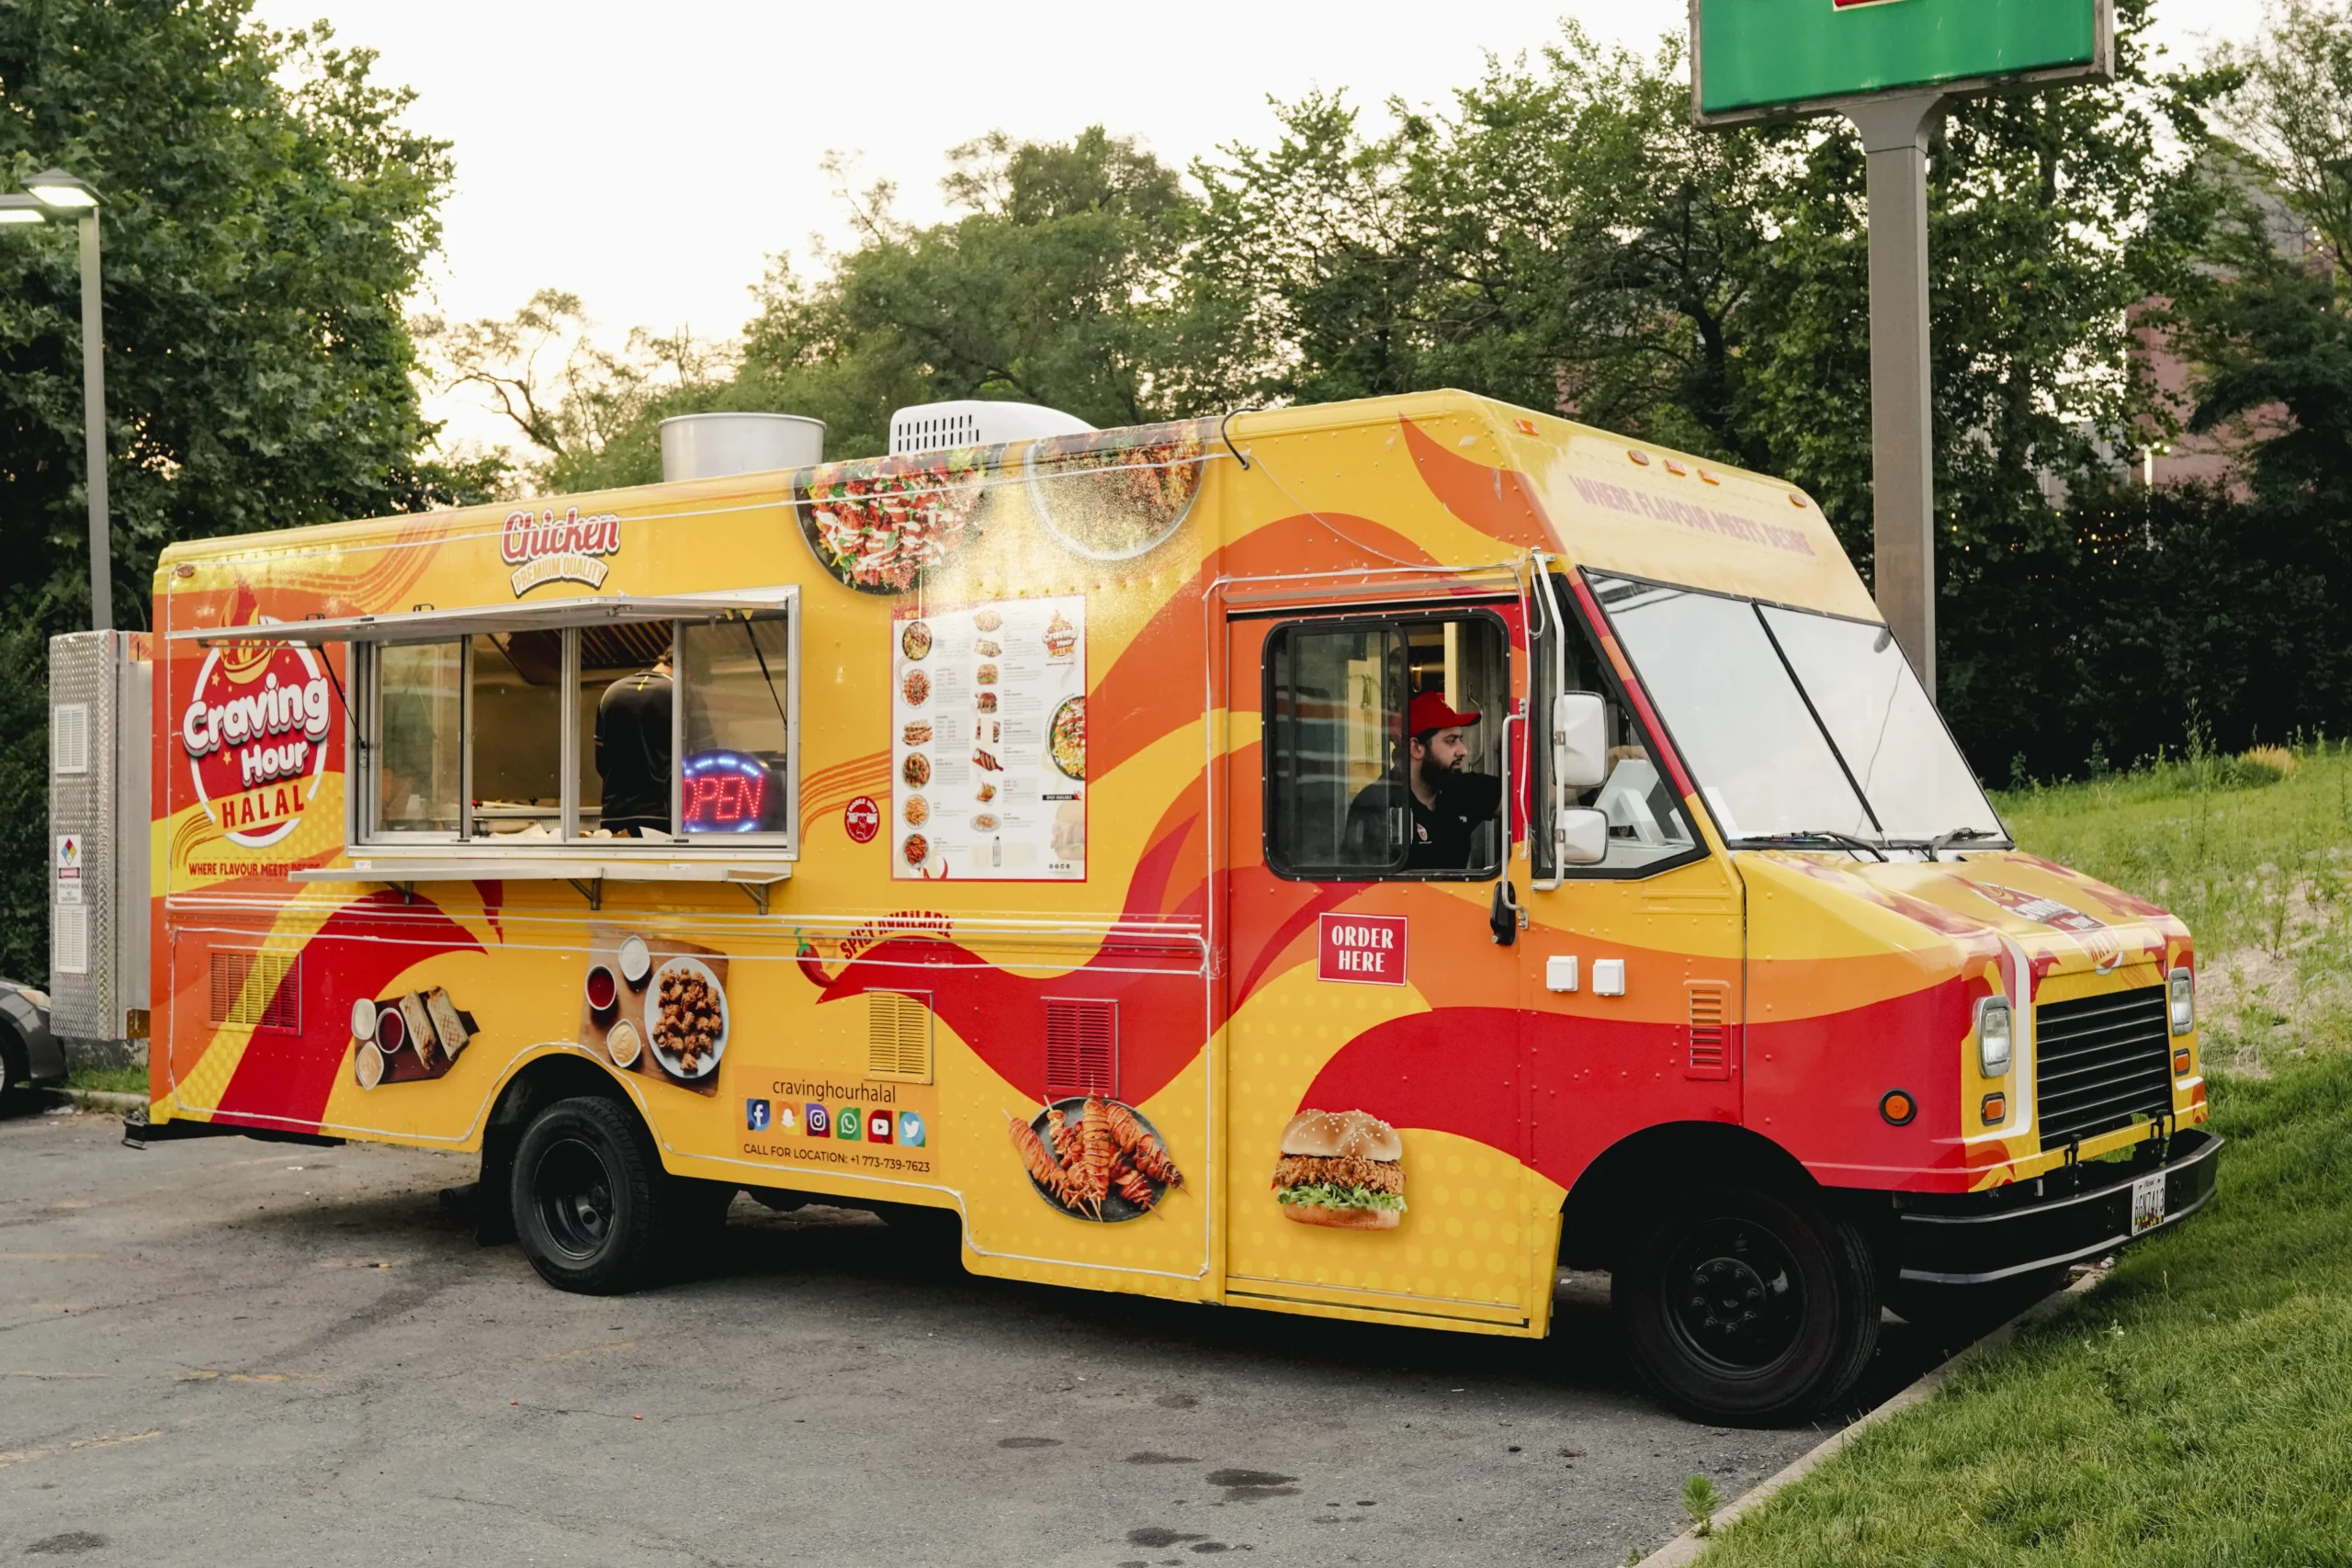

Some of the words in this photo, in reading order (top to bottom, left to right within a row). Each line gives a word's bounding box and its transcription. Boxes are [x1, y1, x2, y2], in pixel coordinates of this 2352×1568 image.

[1568, 474, 1640, 515] WHERE
[1634, 490, 1716, 534] FLAVOUR
[1711, 511, 1767, 546] MEETS
[1761, 522, 1816, 557] DESIRE
[502, 508, 619, 563] Chicken
[514, 557, 560, 592] PREMIUM
[563, 556, 606, 584] QUALITY
[183, 672, 330, 755] Craving
[241, 743, 309, 787] Hour
[222, 784, 305, 829] HALAL
[188, 863, 217, 875] WHERE
[220, 863, 258, 875] FLAVOUR
[260, 863, 289, 876] MEETS
[1331, 925, 1394, 949] ORDER
[1339, 950, 1385, 973] HERE
[773, 1079, 896, 1103] cravinghourhalal
[743, 1143, 768, 1156] CALL
[771, 1145, 791, 1158] FOR
[794, 1148, 848, 1164] LOCATION:
[851, 1155, 860, 1166] +1
[862, 1155, 931, 1173] 773-739-7623
